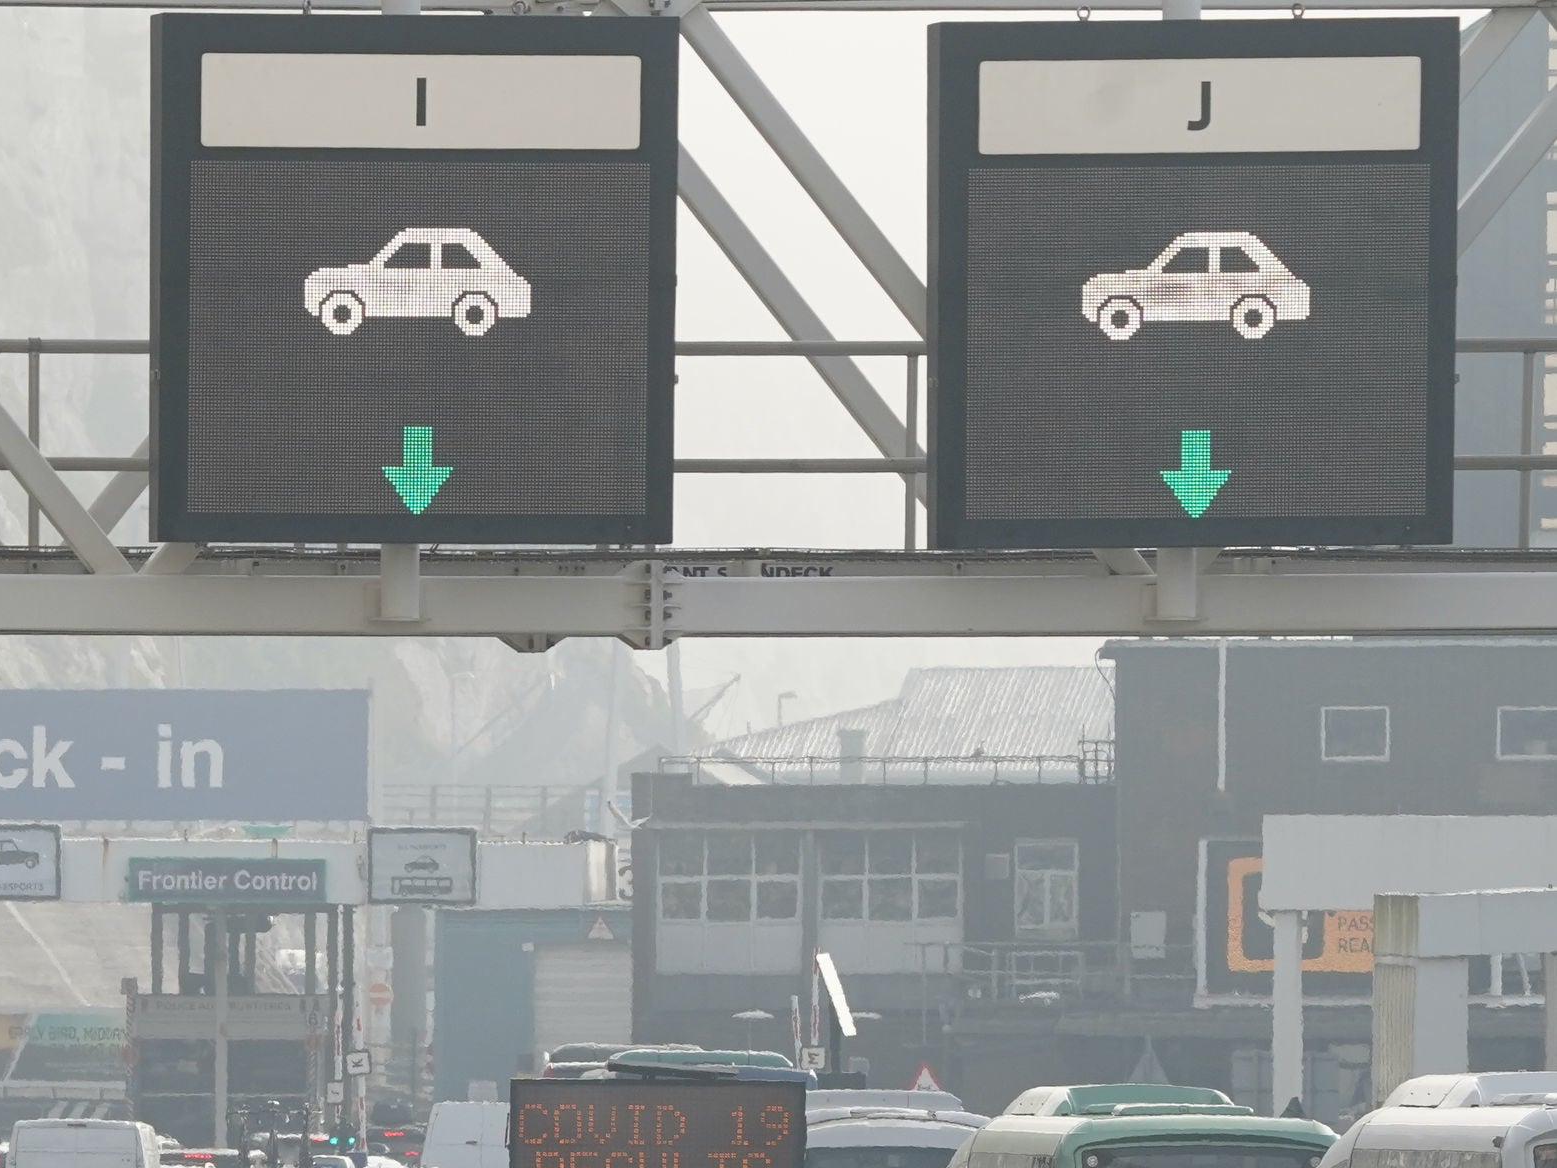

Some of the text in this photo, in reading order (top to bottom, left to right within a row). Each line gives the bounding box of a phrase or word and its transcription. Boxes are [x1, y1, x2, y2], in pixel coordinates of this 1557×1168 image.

[416, 77, 427, 127] I
[1187, 81, 1211, 131] J
[157, 723, 224, 789] in
[137, 869, 318, 891] Frontier Control
[1337, 937, 1374, 953] REA
[156, 1001, 195, 1011] POLICE
[352, 1058, 364, 1069] K
[519, 1104, 791, 1146] COVID 19
